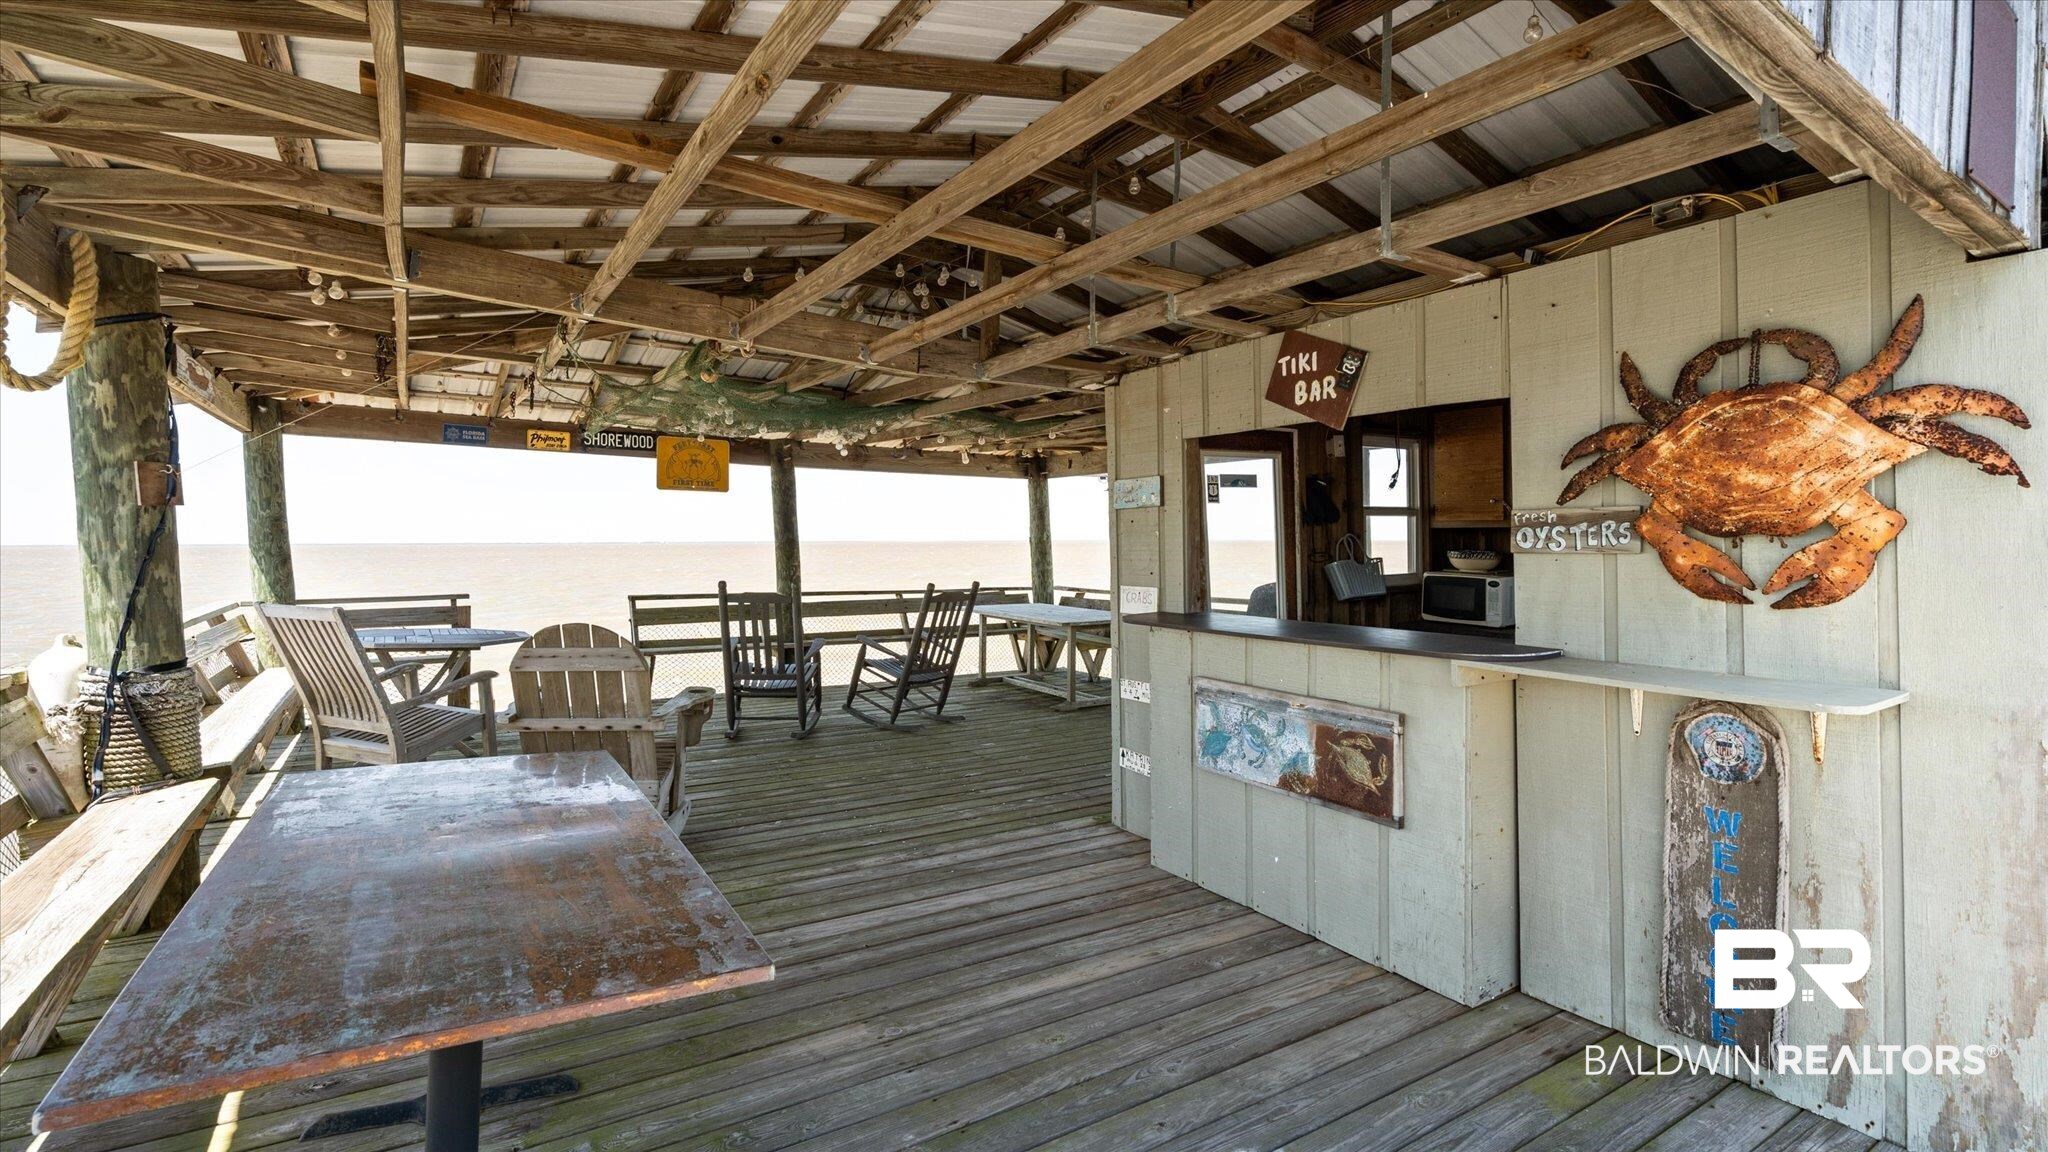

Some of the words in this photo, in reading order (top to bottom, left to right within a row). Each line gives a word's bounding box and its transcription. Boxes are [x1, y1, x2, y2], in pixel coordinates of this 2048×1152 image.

[1278, 351, 1318, 377] TIKI
[1294, 375, 1337, 406] BAR
[584, 431, 654, 449] SHOREWOOD
[1515, 520, 1632, 552] OYSTERS
[1703, 805, 1744, 1046] WELCE
